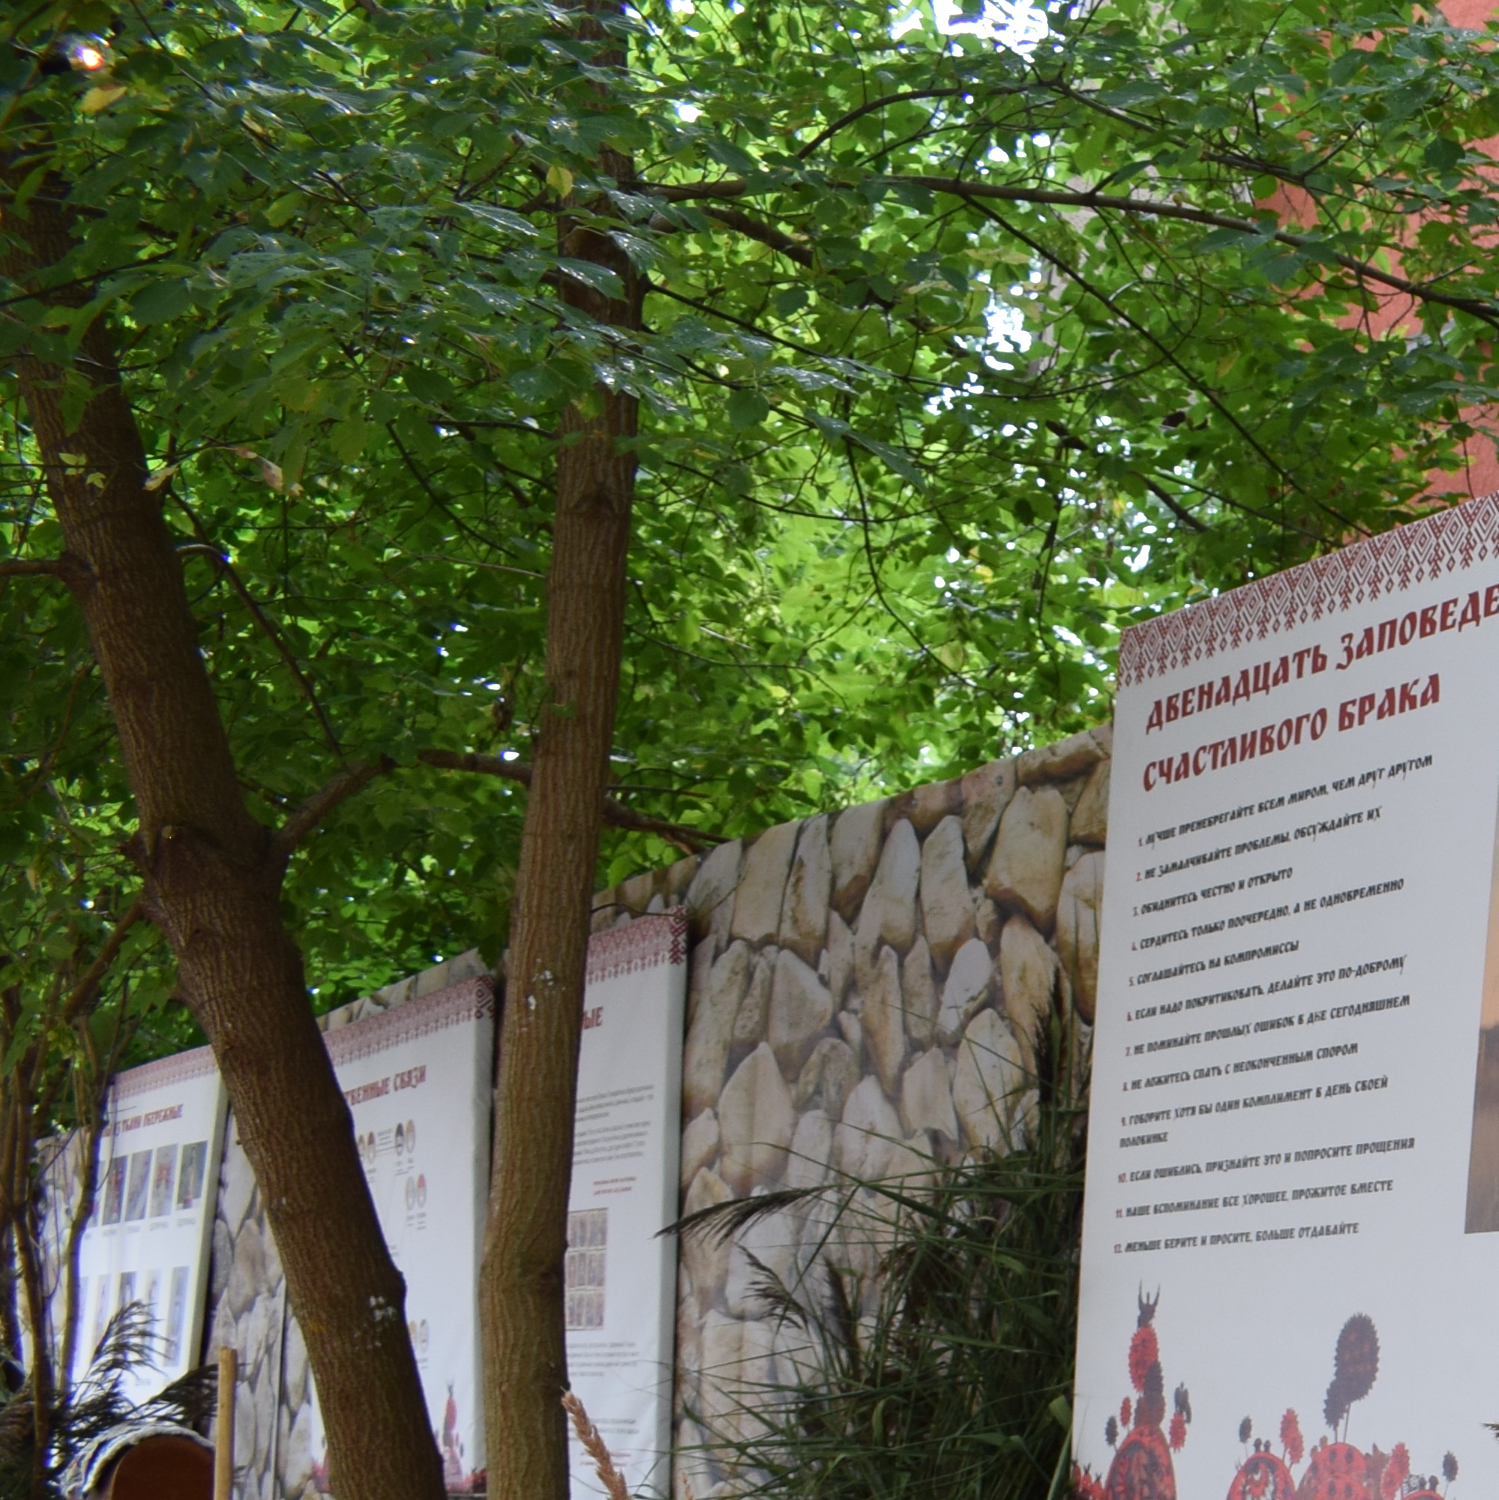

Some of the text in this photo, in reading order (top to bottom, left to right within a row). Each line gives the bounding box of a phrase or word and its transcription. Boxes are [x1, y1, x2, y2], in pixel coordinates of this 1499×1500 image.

[1143, 673, 1441, 792] СЧАСТЛИВОГО БРАКА
[1146, 644, 1328, 735] ДВЕНАДЦАТЬ
